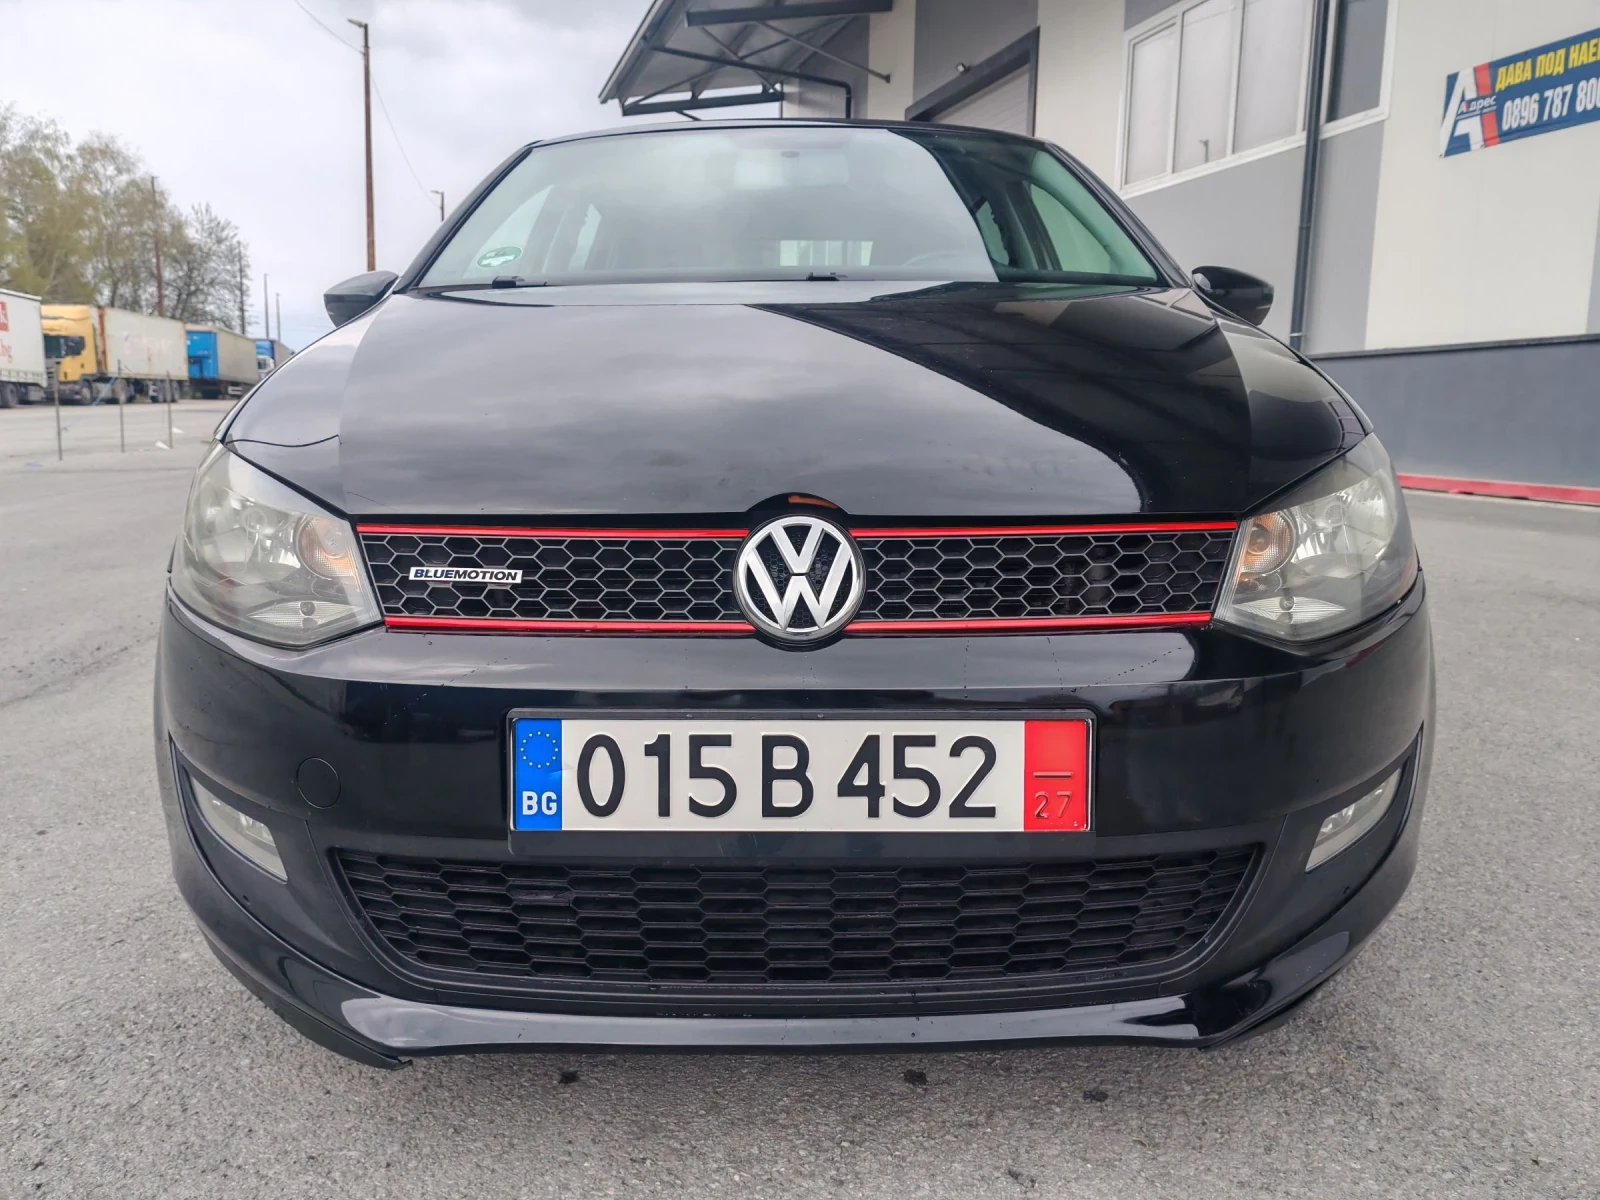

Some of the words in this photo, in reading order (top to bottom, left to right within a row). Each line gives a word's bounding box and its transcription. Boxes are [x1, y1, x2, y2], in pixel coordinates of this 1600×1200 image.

[1495, 59, 1532, 93] ДАВА
[1535, 48, 1566, 77] ПОД
[1568, 37, 1600, 69] НАЕ
[1502, 92, 1540, 131] 0896
[1543, 83, 1574, 120] 787
[413, 568, 518, 581] BLUEMOTION
[577, 734, 737, 817] 015
[761, 734, 814, 818] B
[837, 734, 997, 818] 452
[522, 791, 557, 816] BG
[1034, 791, 1072, 819] 27
